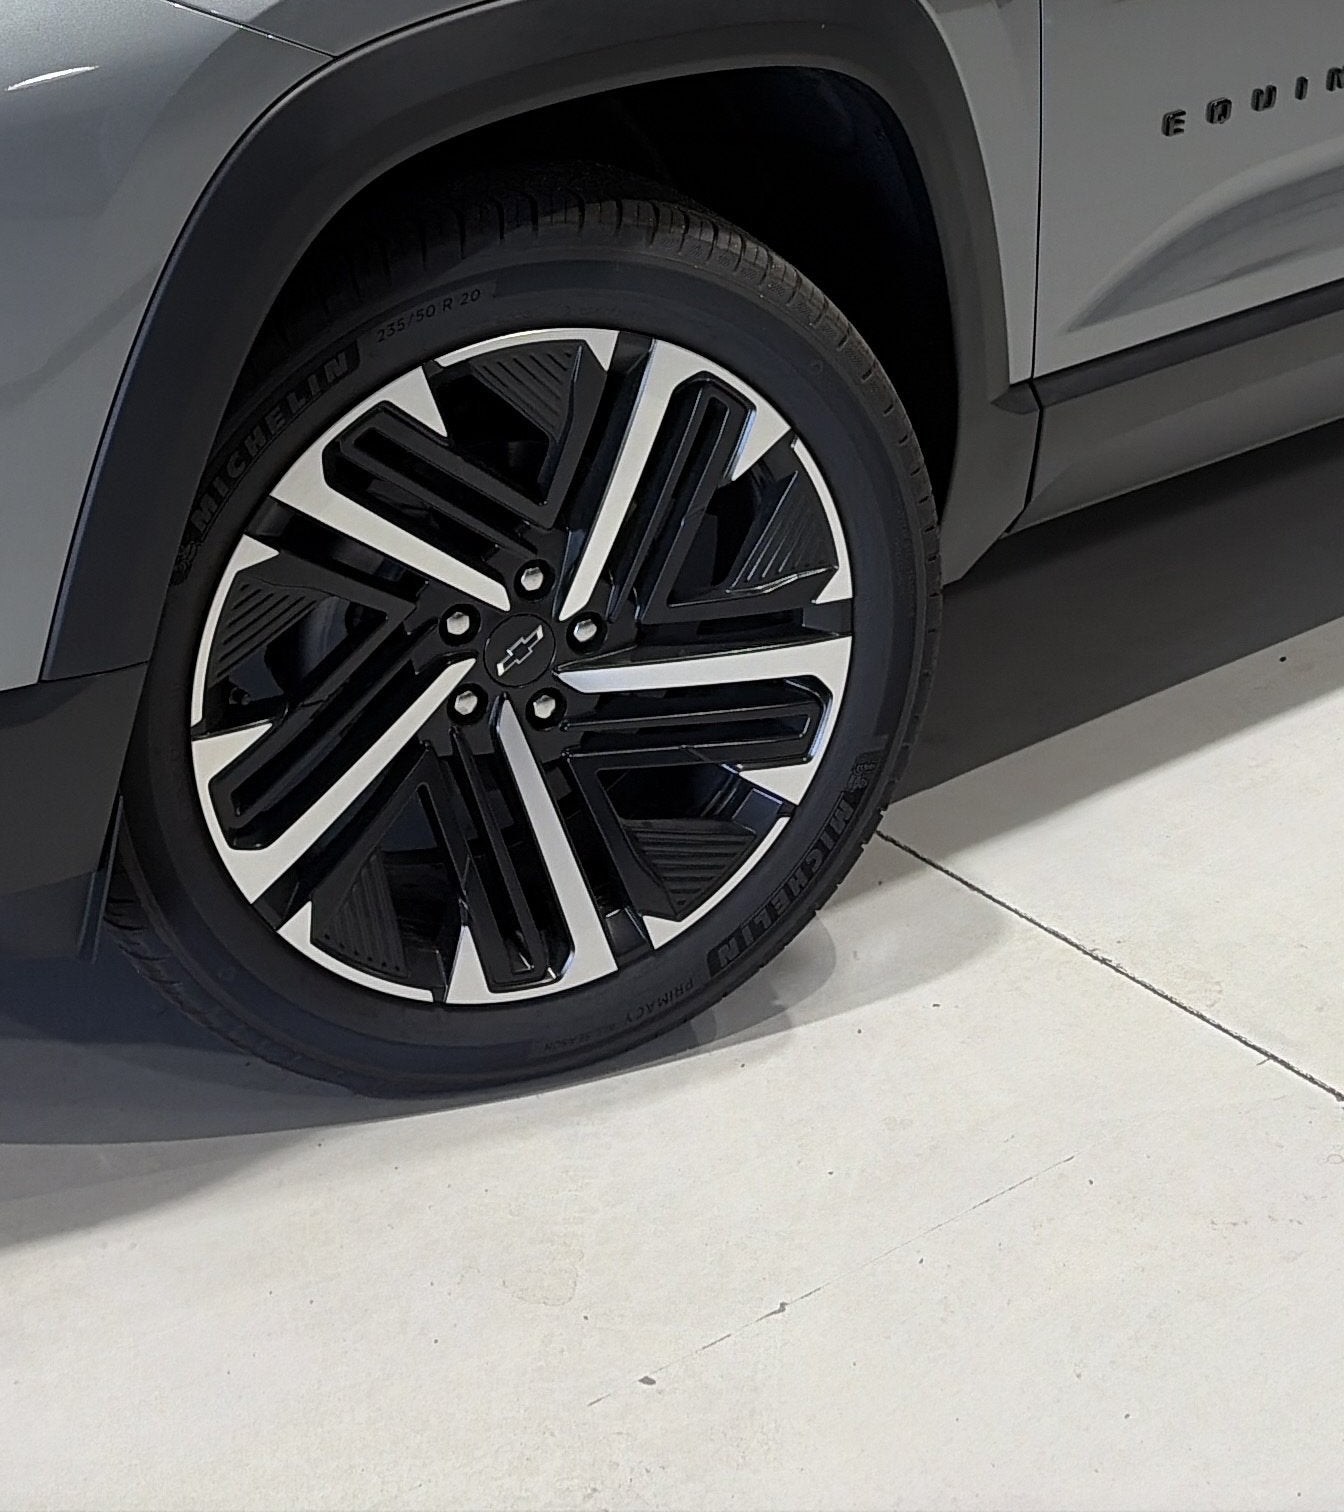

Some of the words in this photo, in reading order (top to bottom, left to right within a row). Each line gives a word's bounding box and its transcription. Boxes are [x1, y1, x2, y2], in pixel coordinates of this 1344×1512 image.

[377, 304, 436, 343] 235/50
[442, 297, 454, 312] R
[460, 288, 481, 306] 20
[191, 350, 350, 534] MICHELIN
[717, 802, 855, 968] MICHELIN
[626, 979, 694, 1023] PRIMACY
